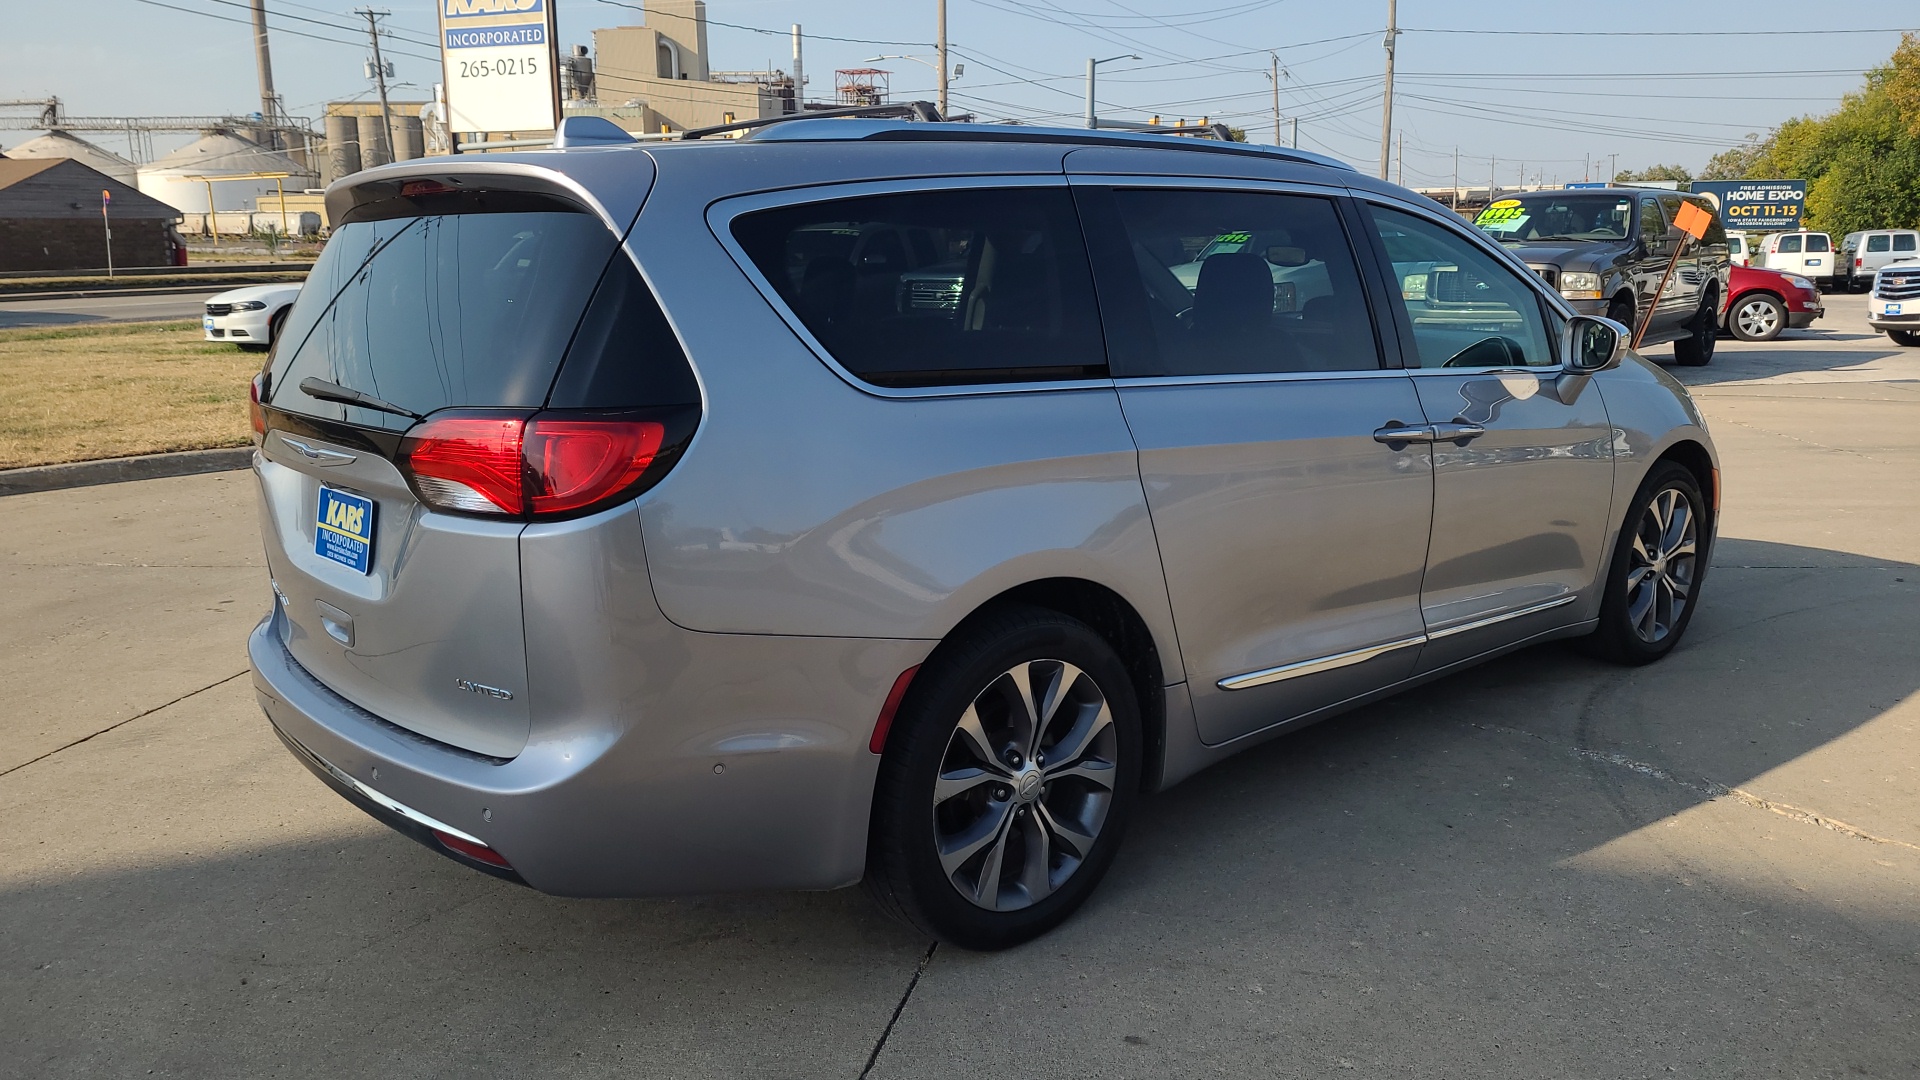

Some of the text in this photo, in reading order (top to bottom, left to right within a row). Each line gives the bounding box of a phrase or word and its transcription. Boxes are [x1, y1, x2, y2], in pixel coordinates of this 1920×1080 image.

[448, 29, 542, 46] INCORPORATED
[460, 57, 537, 78] 265-0215
[1726, 190, 1804, 201] HOME EXPO
[1728, 205, 1798, 216] OCT 11-13
[326, 498, 365, 535] KARS
[321, 529, 364, 554] INCORPORATED
[455, 678, 513, 700] LIMITED
